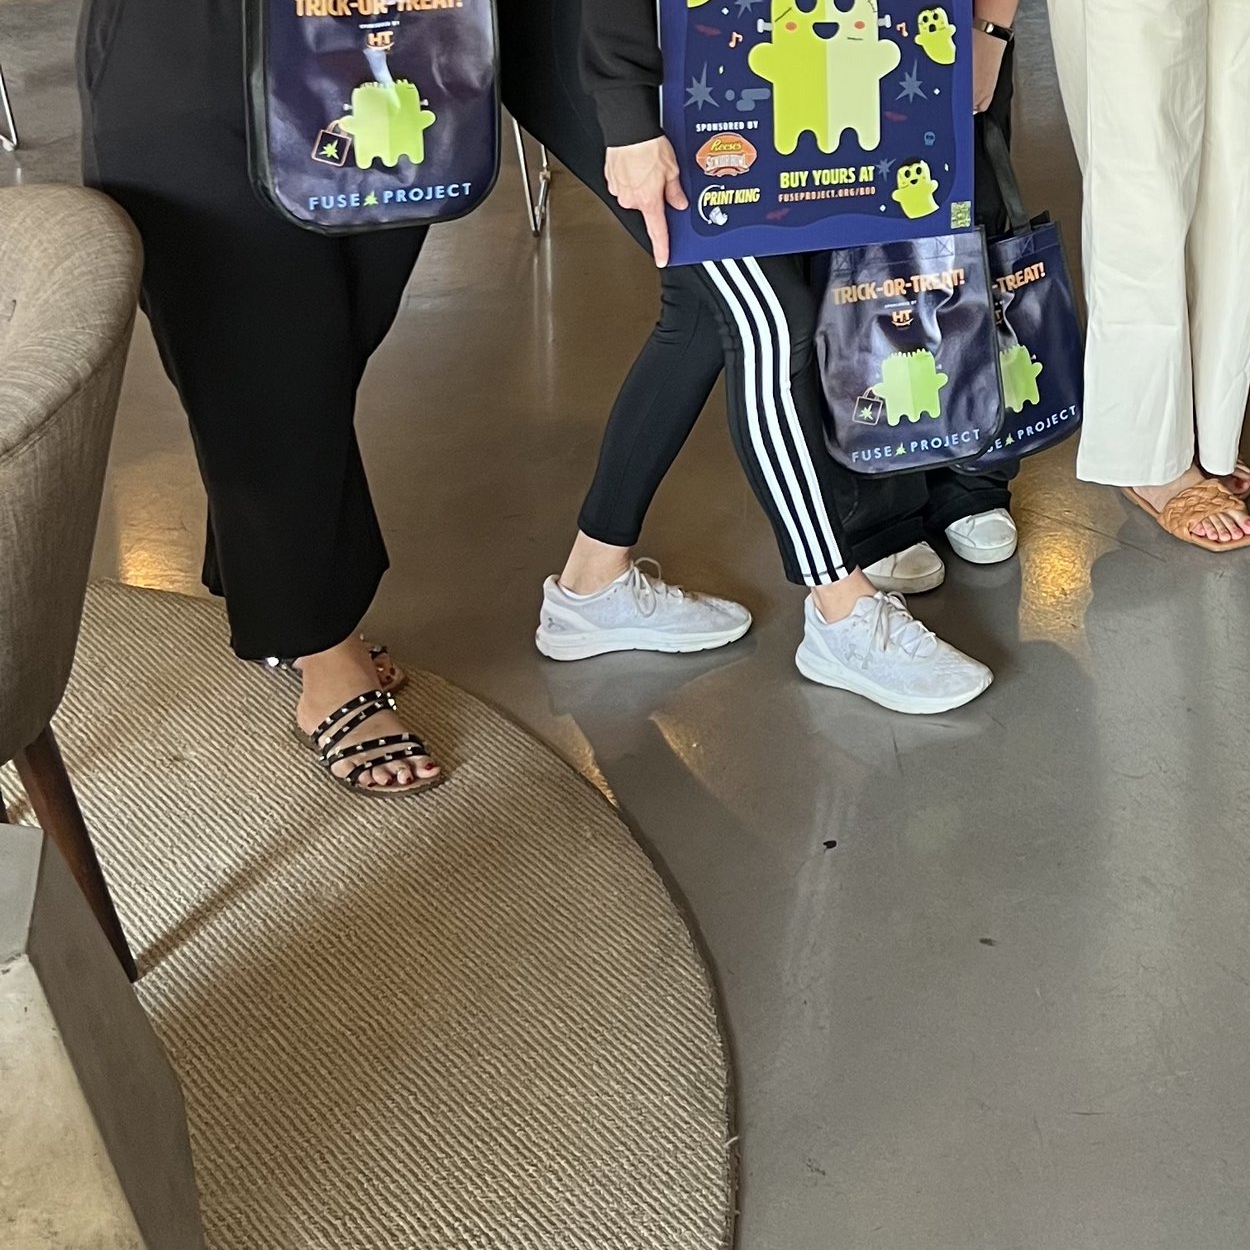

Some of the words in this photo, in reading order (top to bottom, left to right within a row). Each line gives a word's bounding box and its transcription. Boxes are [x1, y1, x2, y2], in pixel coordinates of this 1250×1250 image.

[695, 121, 745, 133] SPONSORED
[747, 120, 759, 130] BY
[779, 170, 809, 189] BUY
[812, 168, 856, 186] YOURS
[858, 165, 876, 182] AT
[309, 192, 360, 211] FUSE
[383, 182, 472, 204] PROJECT
[703, 189, 735, 207] PRINT
[734, 187, 760, 204] KING
[831, 268, 965, 305] TRICK-OR-TREAT!
[1017, 404, 1078, 443] PROJECT
[852, 445, 892, 463] FUSE
[910, 428, 981, 453] PROJECT
